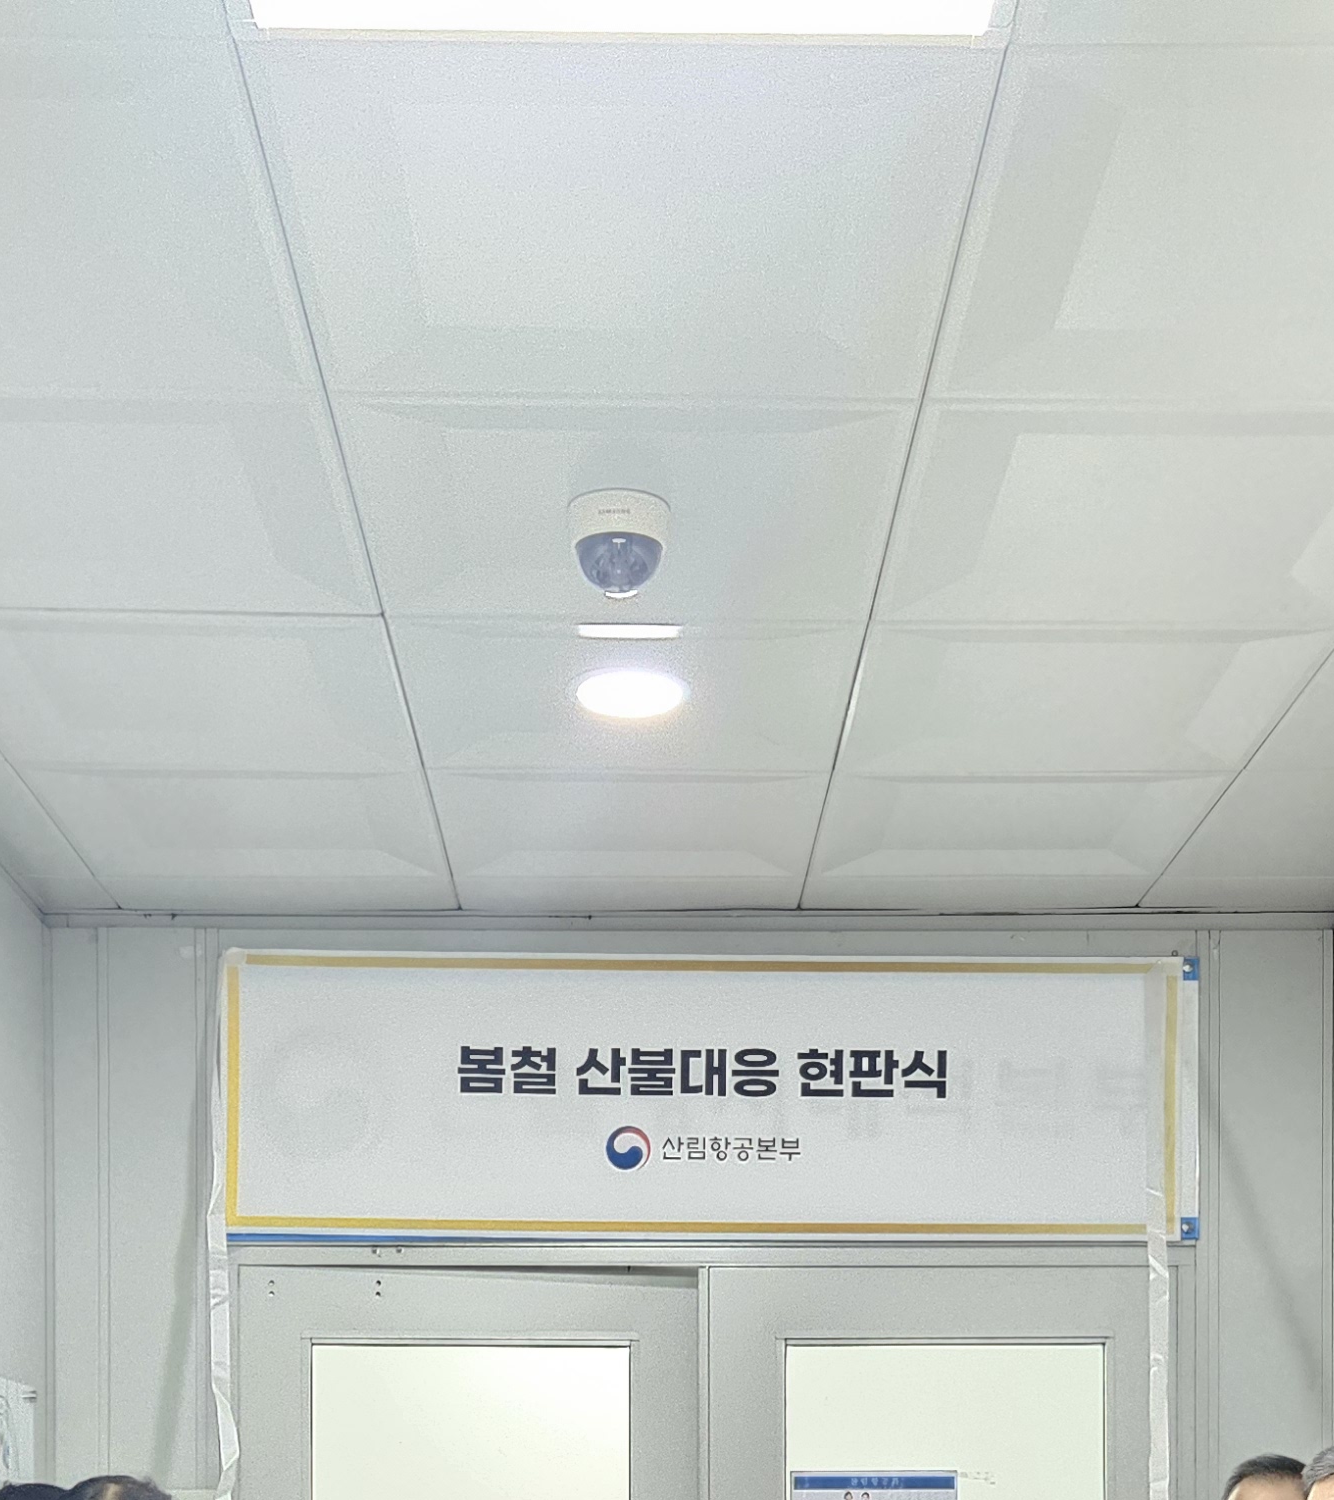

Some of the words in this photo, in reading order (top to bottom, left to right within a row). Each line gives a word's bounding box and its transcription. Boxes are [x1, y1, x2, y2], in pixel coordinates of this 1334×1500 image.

[457, 1045, 557, 1095] 봄철
[576, 1047, 780, 1098] 산불대응
[797, 1048, 948, 1099] 현판식
[662, 1136, 802, 1162] 산림항공본부
